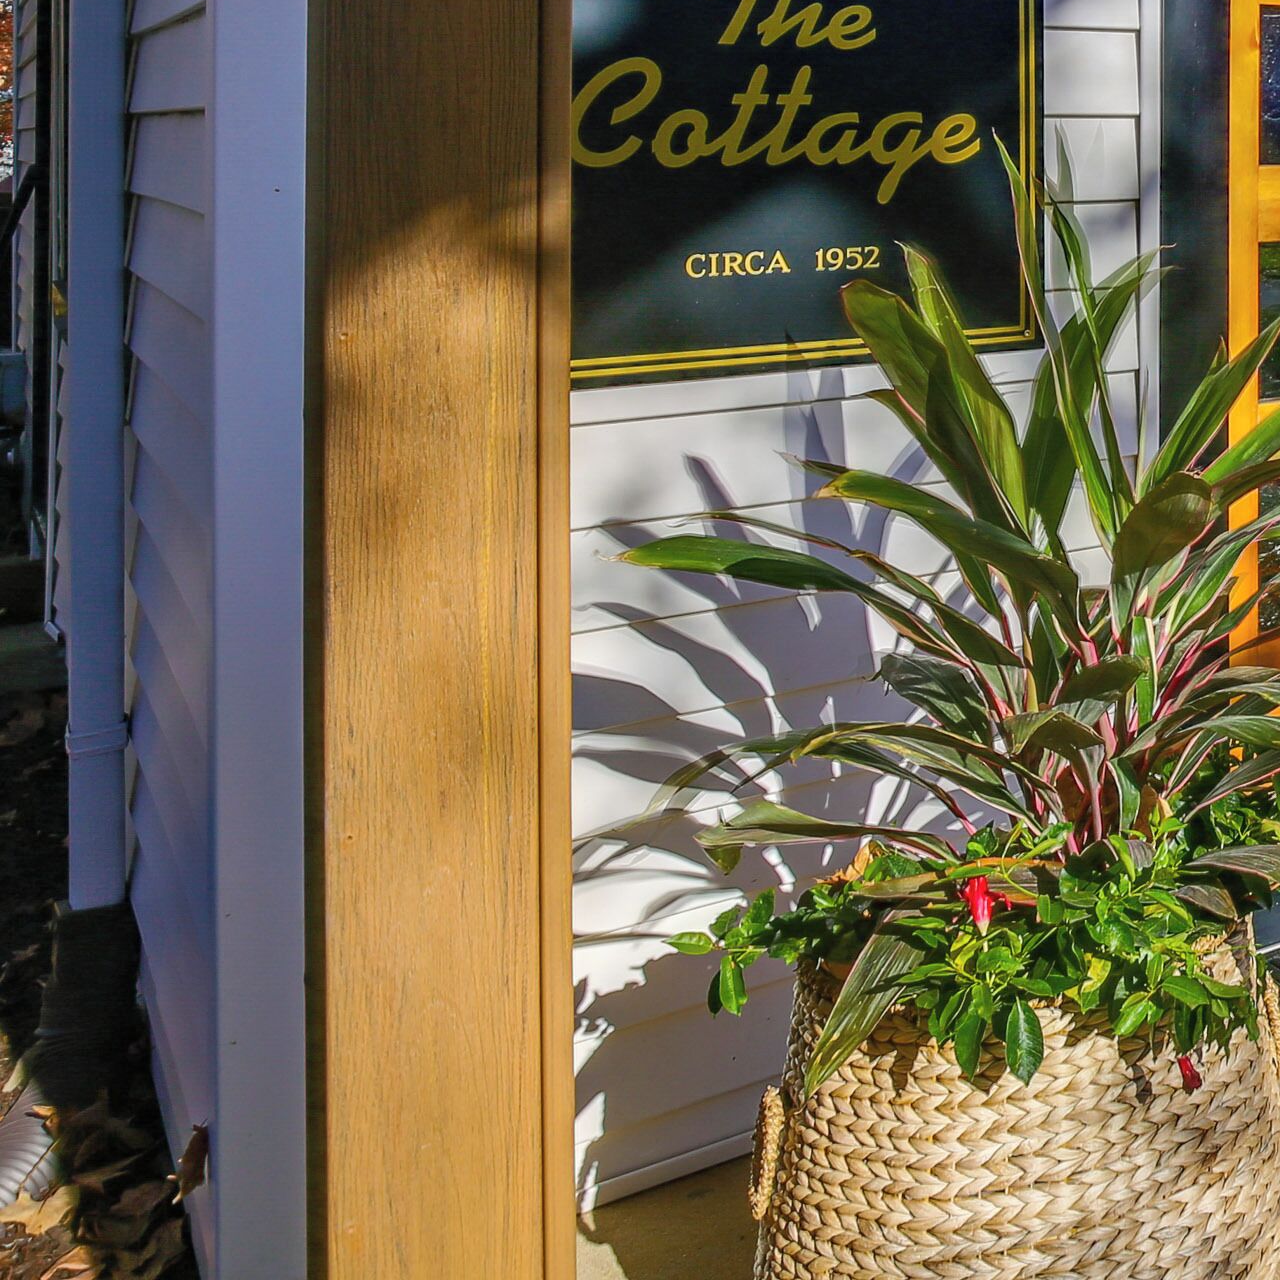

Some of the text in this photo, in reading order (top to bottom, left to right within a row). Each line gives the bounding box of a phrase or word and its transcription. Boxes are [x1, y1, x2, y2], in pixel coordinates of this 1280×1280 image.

[571, 57, 980, 204] Cottage
[685, 246, 881, 279] CIRCA 1952
